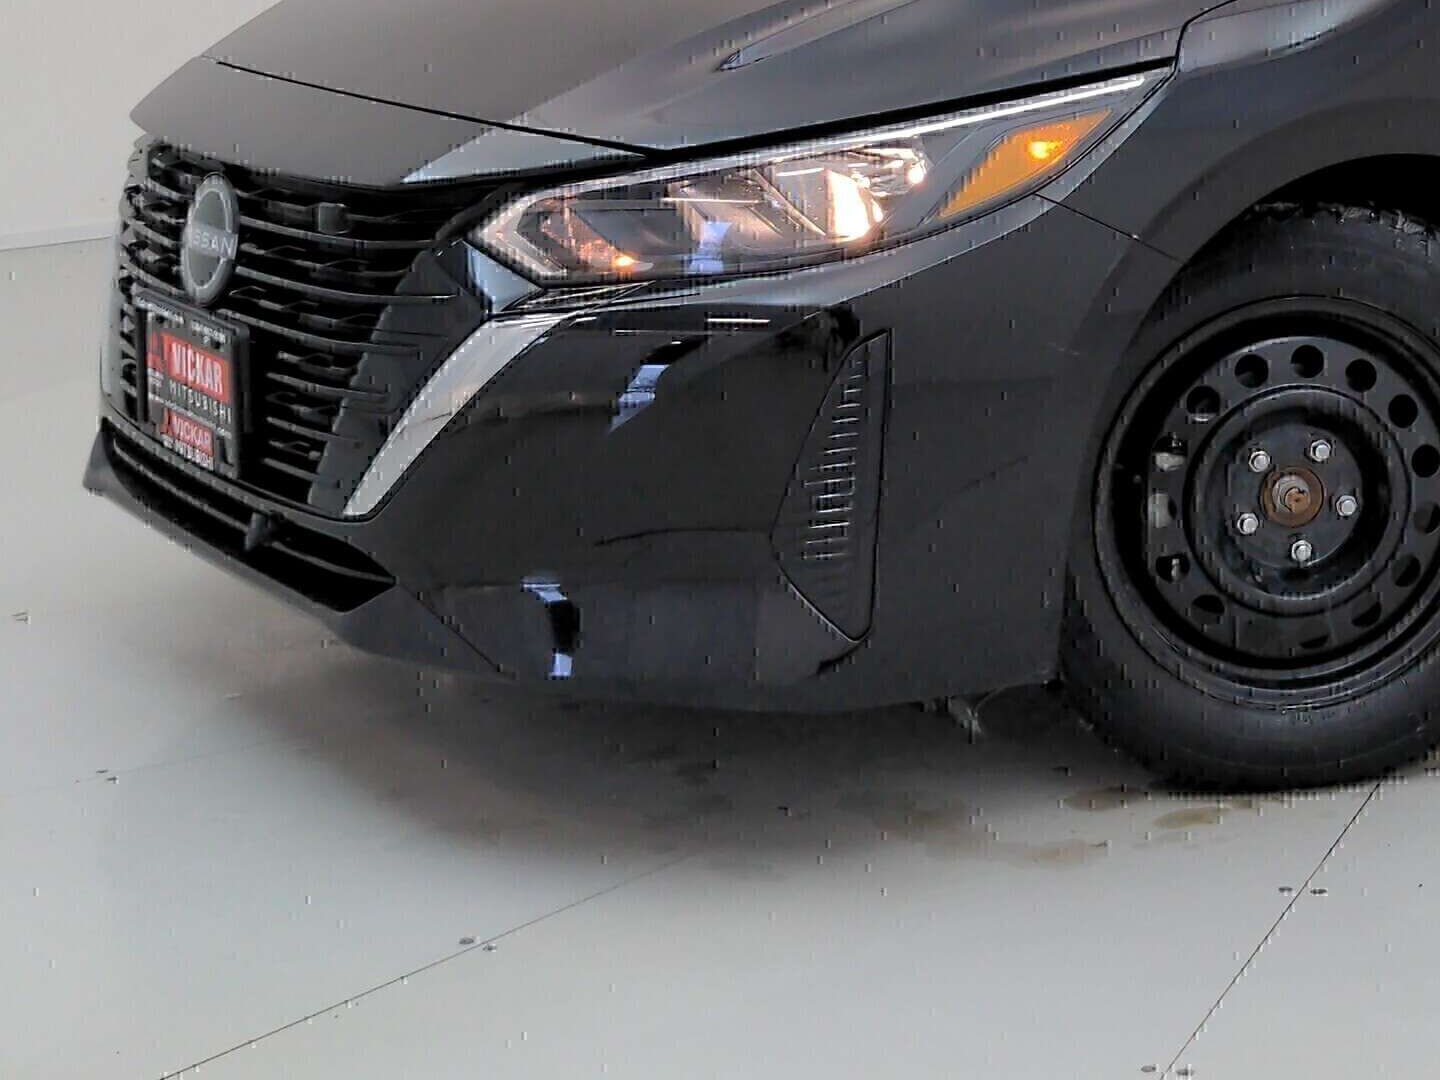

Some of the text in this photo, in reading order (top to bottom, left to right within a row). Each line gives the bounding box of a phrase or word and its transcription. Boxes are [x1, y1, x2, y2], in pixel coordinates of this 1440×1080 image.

[187, 229, 235, 257] SSAN
[171, 340, 223, 396] VICKAR
[169, 379, 232, 425] MITSUBISHI
